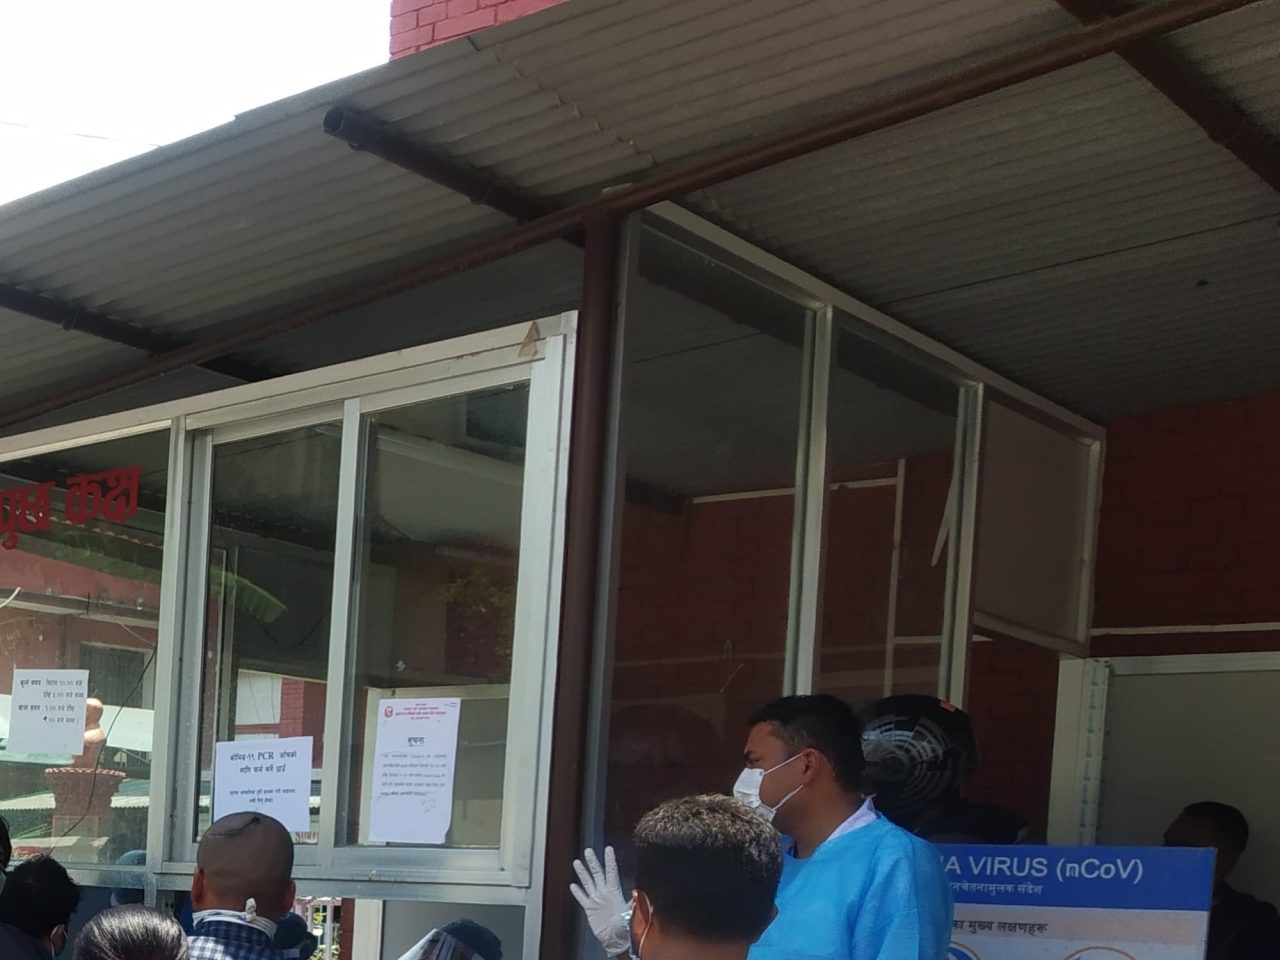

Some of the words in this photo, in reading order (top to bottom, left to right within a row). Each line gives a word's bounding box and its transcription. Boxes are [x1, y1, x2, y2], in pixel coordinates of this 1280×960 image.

[65, 463, 145, 525] कक्ष
[408, 736, 424, 747] सूचना
[258, 751, 274, 761] PCR
[968, 856, 1049, 878] VIRUS
[1056, 857, 1144, 883] (nCoV)
[968, 920, 993, 934] मुख्य
